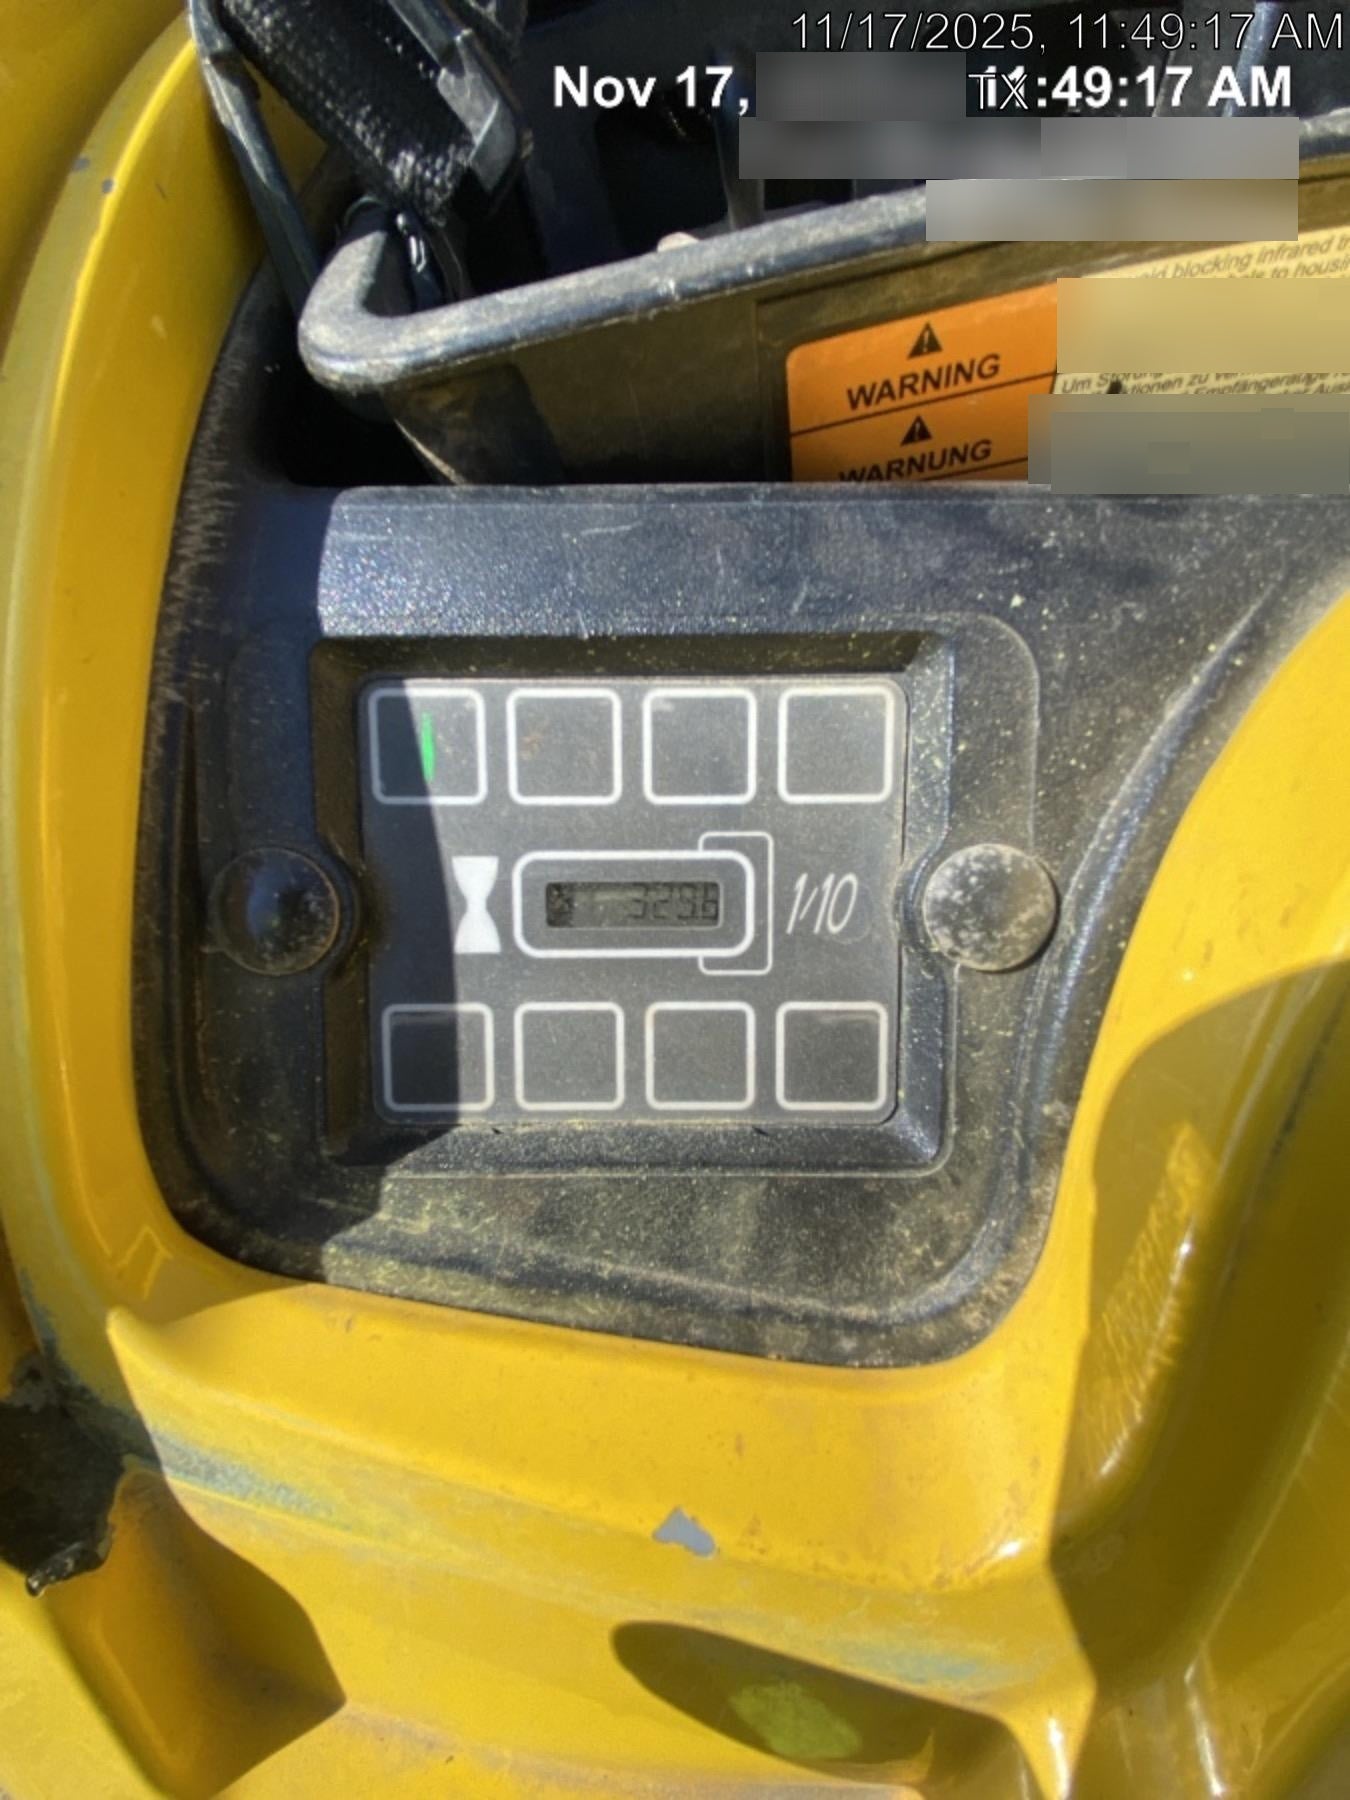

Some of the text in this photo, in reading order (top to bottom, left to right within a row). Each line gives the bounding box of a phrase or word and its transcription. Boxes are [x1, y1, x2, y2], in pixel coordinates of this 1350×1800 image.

[845, 352, 1001, 411] WARNING
[838, 438, 993, 482] WARNUNG
[785, 872, 858, 935] 1/10
